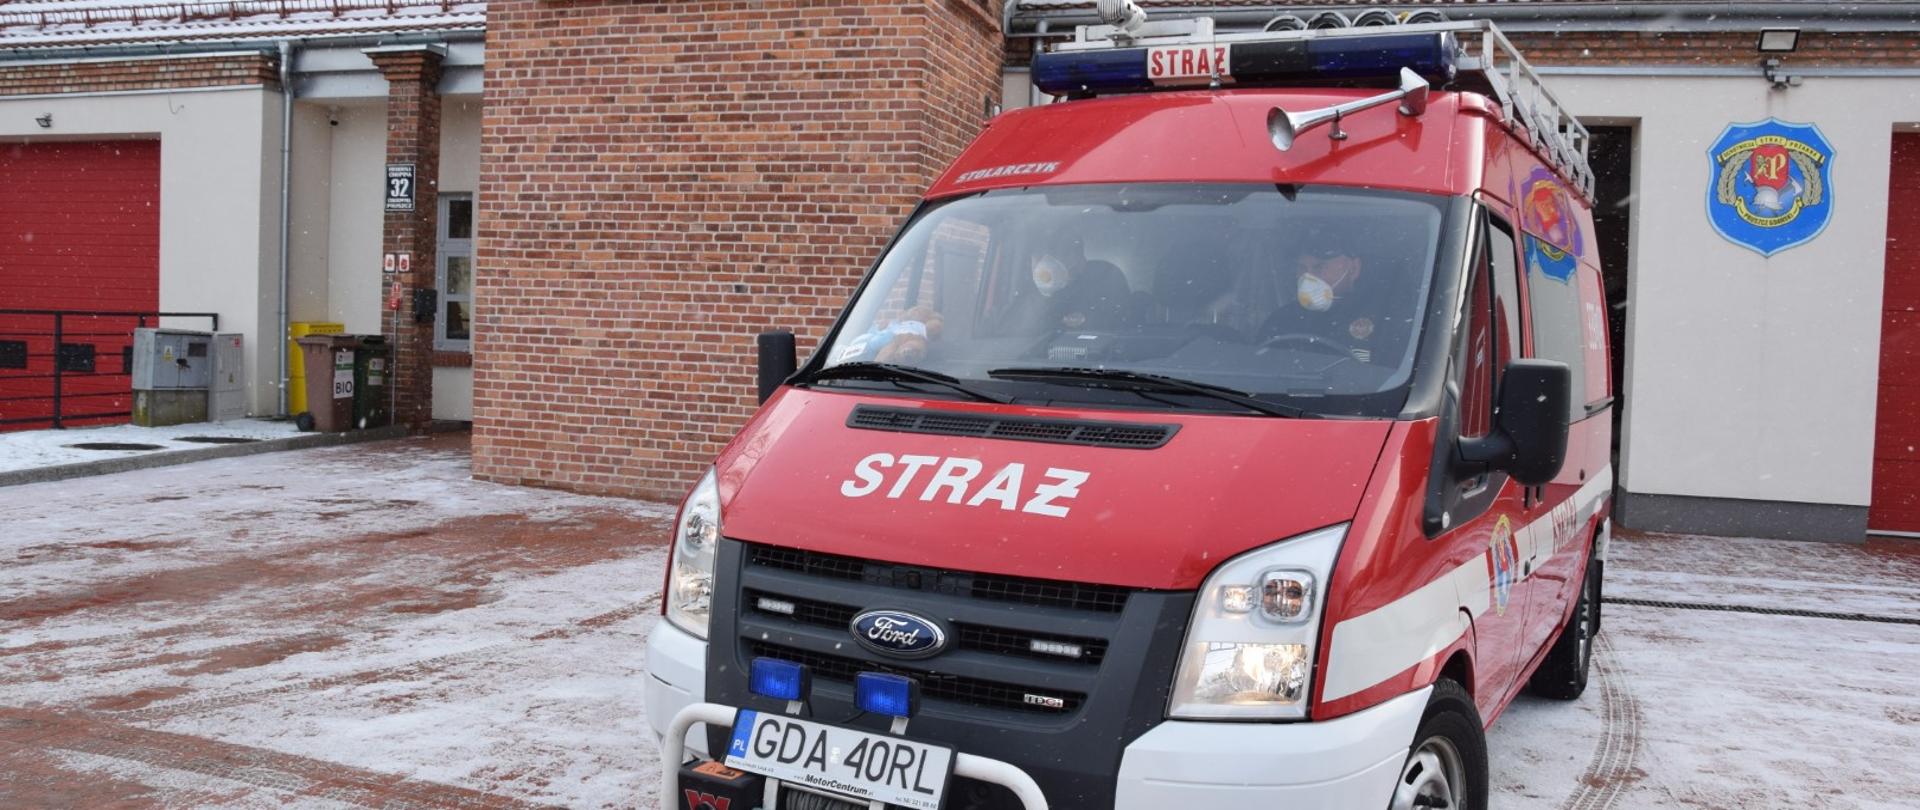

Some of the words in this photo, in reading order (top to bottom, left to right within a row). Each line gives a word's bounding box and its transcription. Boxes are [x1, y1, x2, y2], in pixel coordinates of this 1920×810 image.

[954, 161, 1061, 184] STOLARCZYK
[390, 178, 409, 197] 32
[335, 381, 353, 394] BIO
[868, 616, 920, 646] Ford
[733, 739, 746, 752] PL
[753, 718, 828, 773] GDA
[843, 737, 936, 796] 40RL
